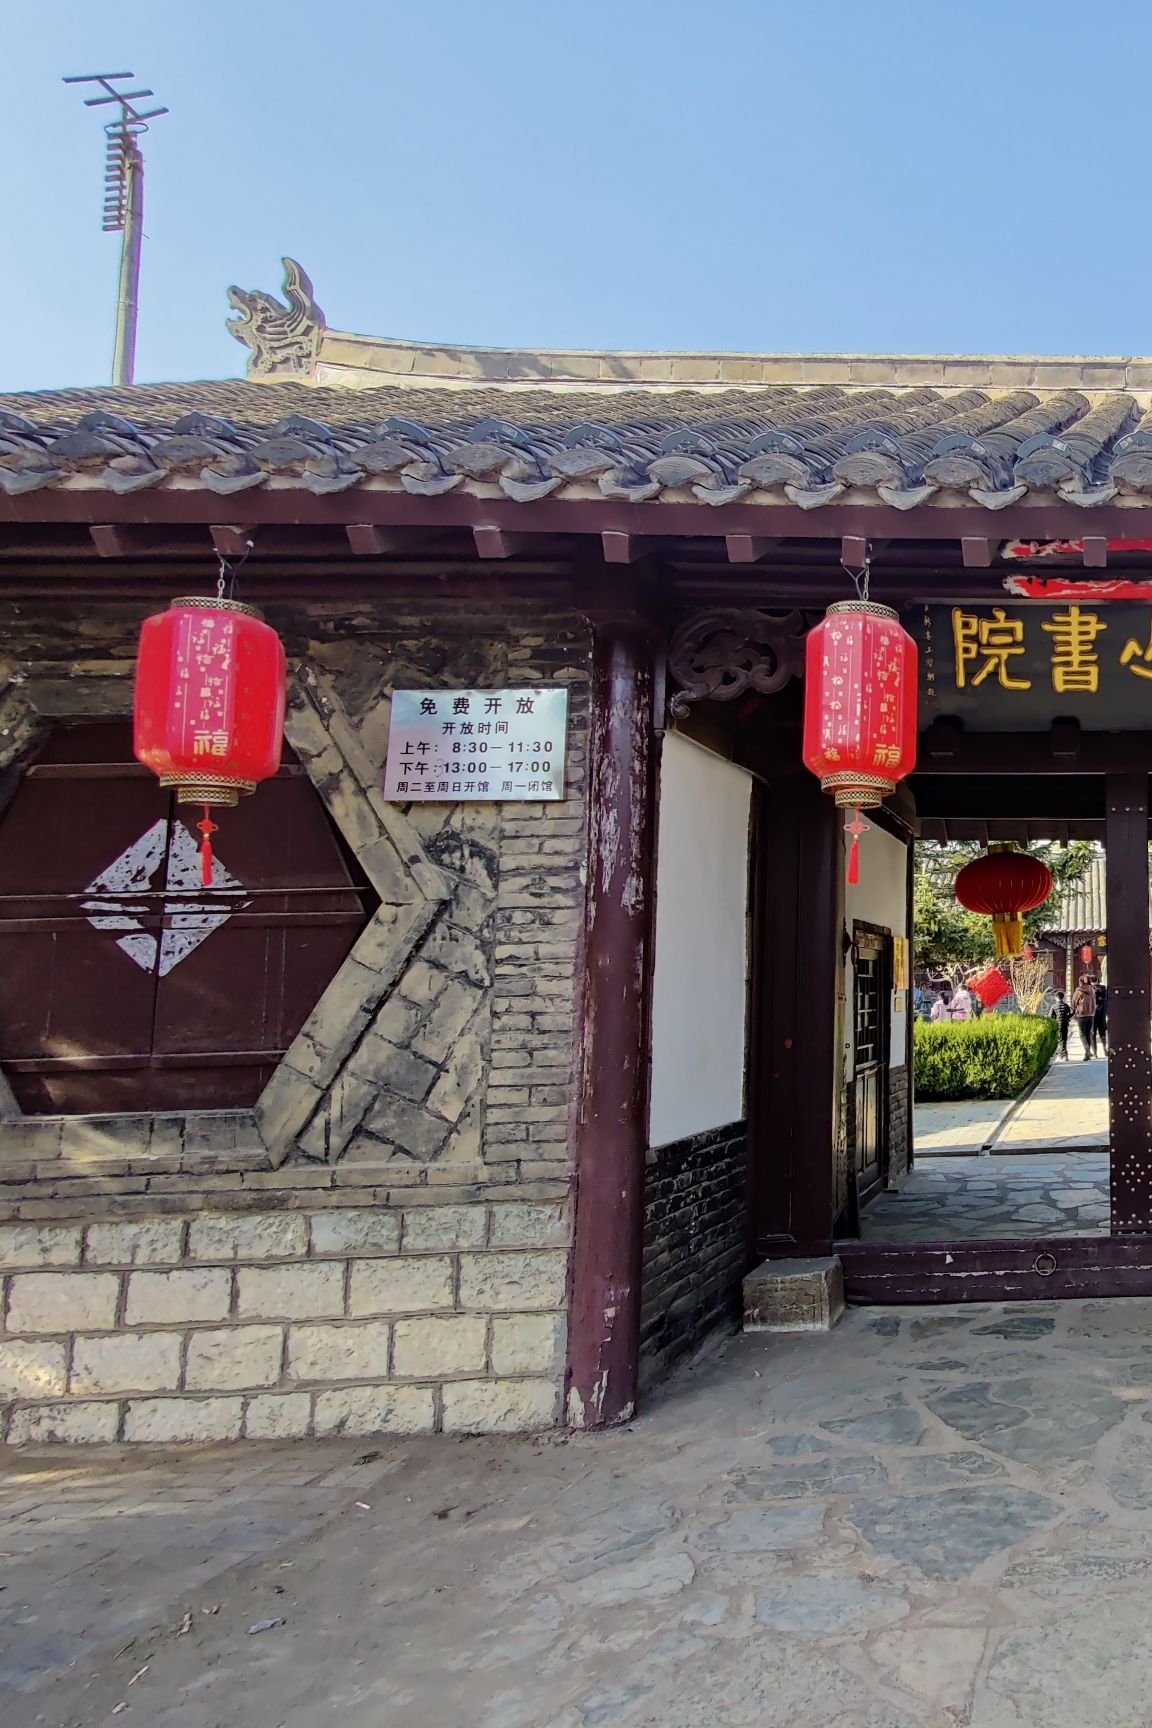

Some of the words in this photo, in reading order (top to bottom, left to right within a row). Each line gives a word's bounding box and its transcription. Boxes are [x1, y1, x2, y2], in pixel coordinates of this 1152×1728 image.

[419, 697, 535, 716] 免费开放
[441, 721, 509, 736] 开放时间
[396, 781, 490, 794] 周二至周日开馆
[501, 780, 553, 793] 周一闭馆
